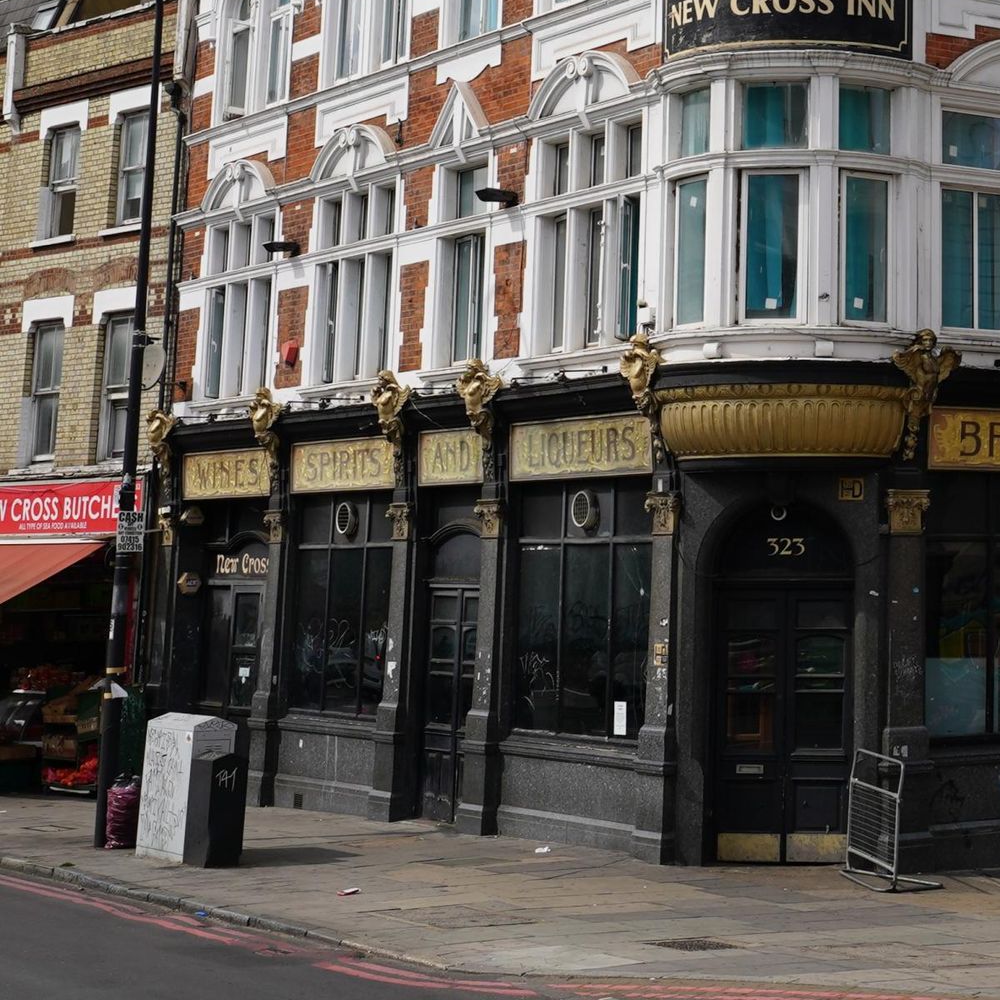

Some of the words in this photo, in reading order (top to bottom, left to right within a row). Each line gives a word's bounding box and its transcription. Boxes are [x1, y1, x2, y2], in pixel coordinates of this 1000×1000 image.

[432, 440, 470, 474] AND
[527, 426, 636, 468] LIQUEURS
[197, 458, 259, 490] WINES
[307, 449, 382, 482] SPIRITS
[11, 497, 59, 521] CROSS
[119, 511, 144, 522] CASH
[766, 538, 806, 556] 323
[216, 554, 240, 574] New
